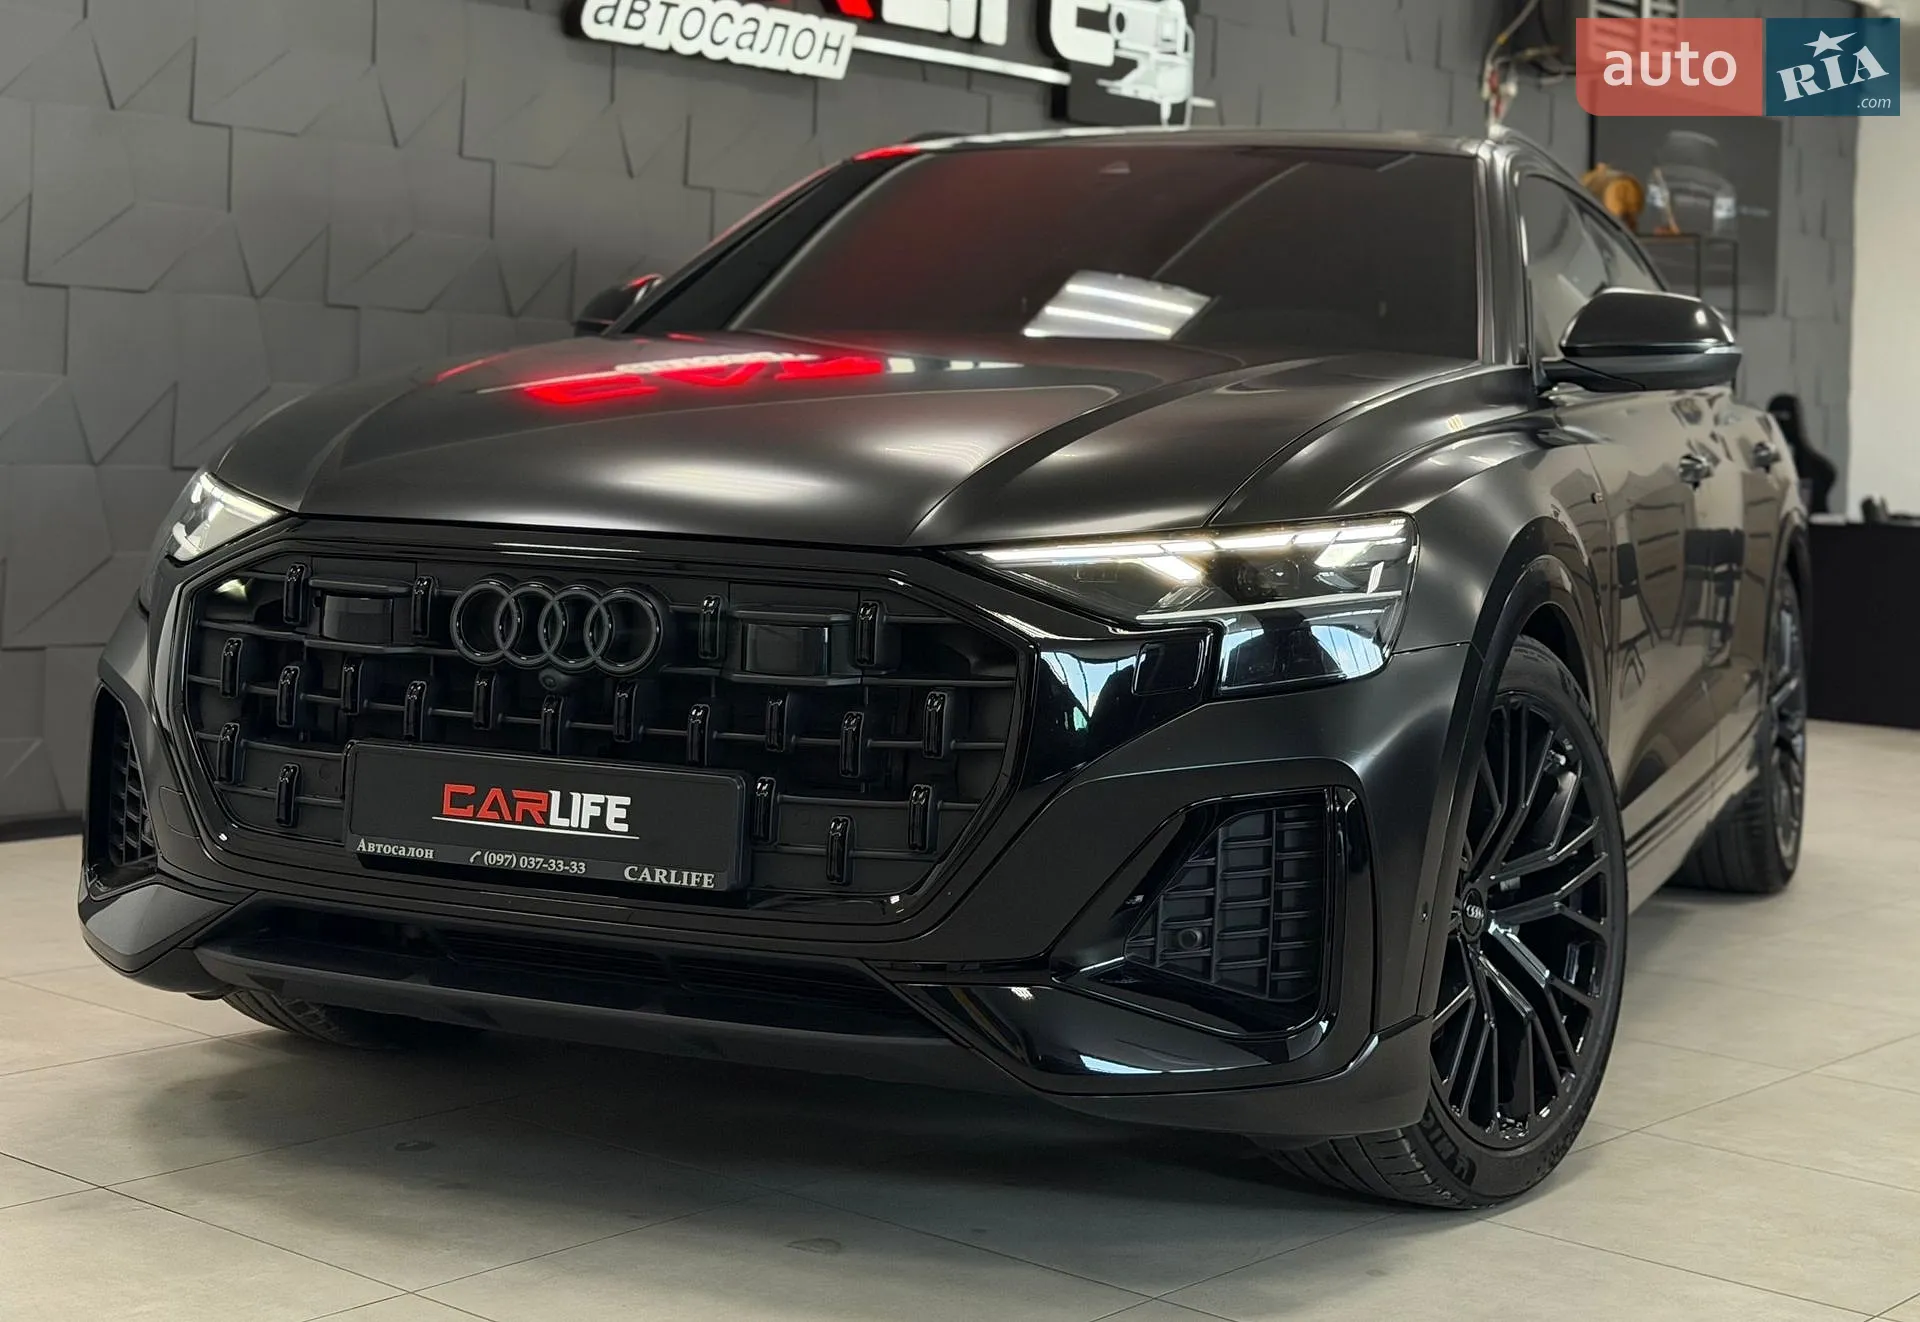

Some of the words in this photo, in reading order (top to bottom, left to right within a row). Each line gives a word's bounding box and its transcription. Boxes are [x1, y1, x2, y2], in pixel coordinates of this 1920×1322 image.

[594, 0, 846, 65] автосалон
[443, 783, 631, 832] CARLIFE
[357, 838, 434, 859] Автосалон
[484, 851, 516, 868] (097)
[519, 857, 586, 874] 037-33-33
[624, 866, 715, 889] CARLIFE
